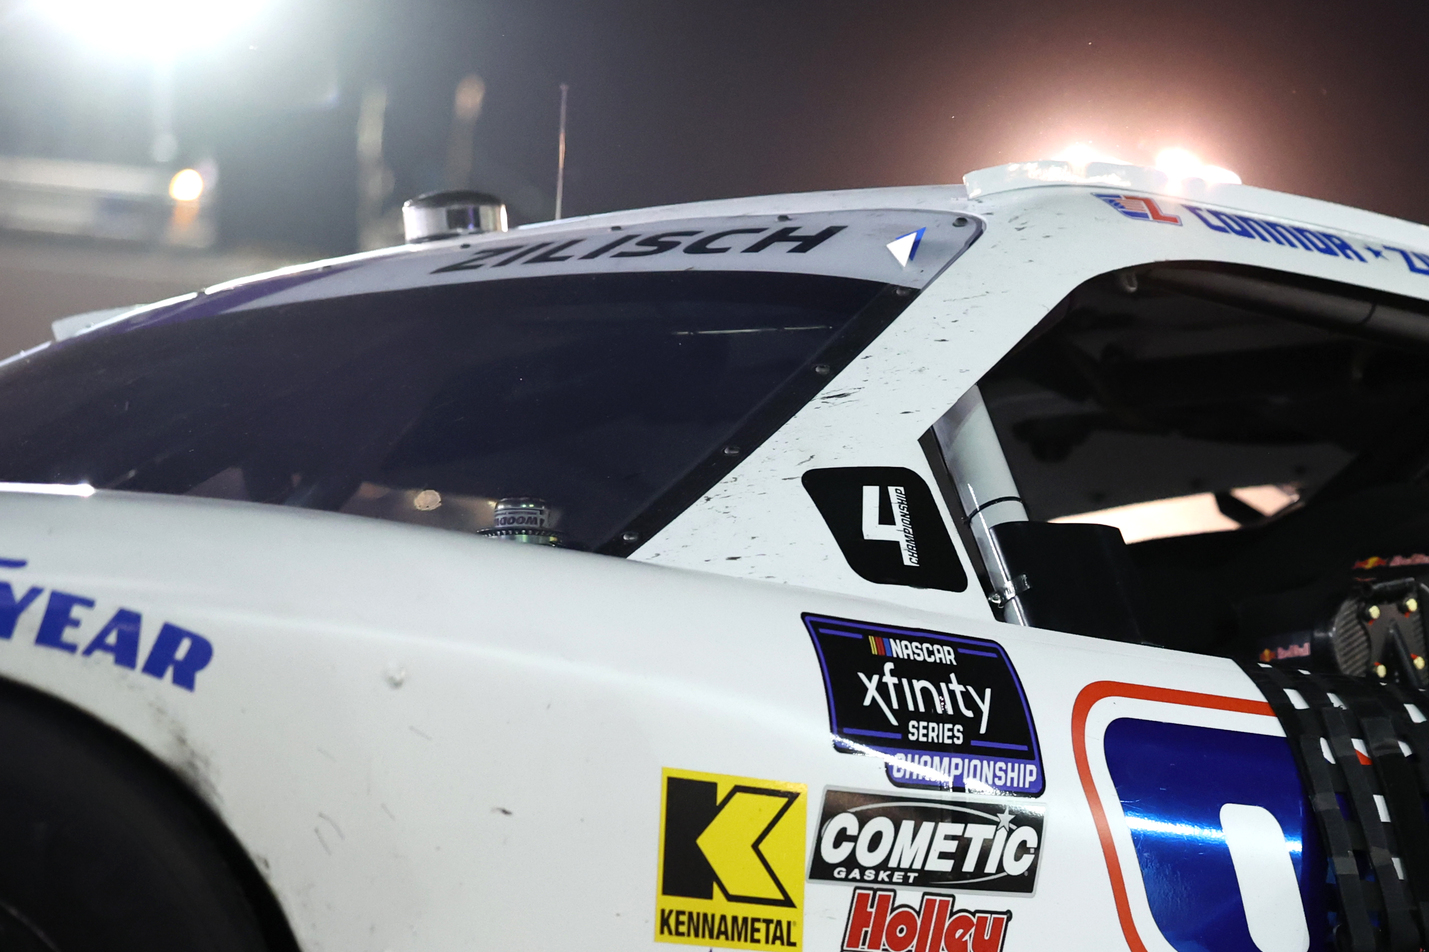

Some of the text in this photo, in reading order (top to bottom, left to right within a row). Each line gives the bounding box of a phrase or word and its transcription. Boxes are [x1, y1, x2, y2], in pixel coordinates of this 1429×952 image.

[430, 225, 848, 275] ZILISCH
[1181, 205, 1368, 263] CONNOR
[862, 485, 920, 567] 4
[889, 638, 957, 666] NASCAR
[856, 662, 992, 734] xfinity
[907, 720, 963, 745] SERIES
[892, 752, 1037, 789] CHAMPIONSHIP
[820, 812, 1038, 877] COMETIC
[832, 867, 919, 884] GASKET
[659, 908, 798, 948] KENNAMETAL
